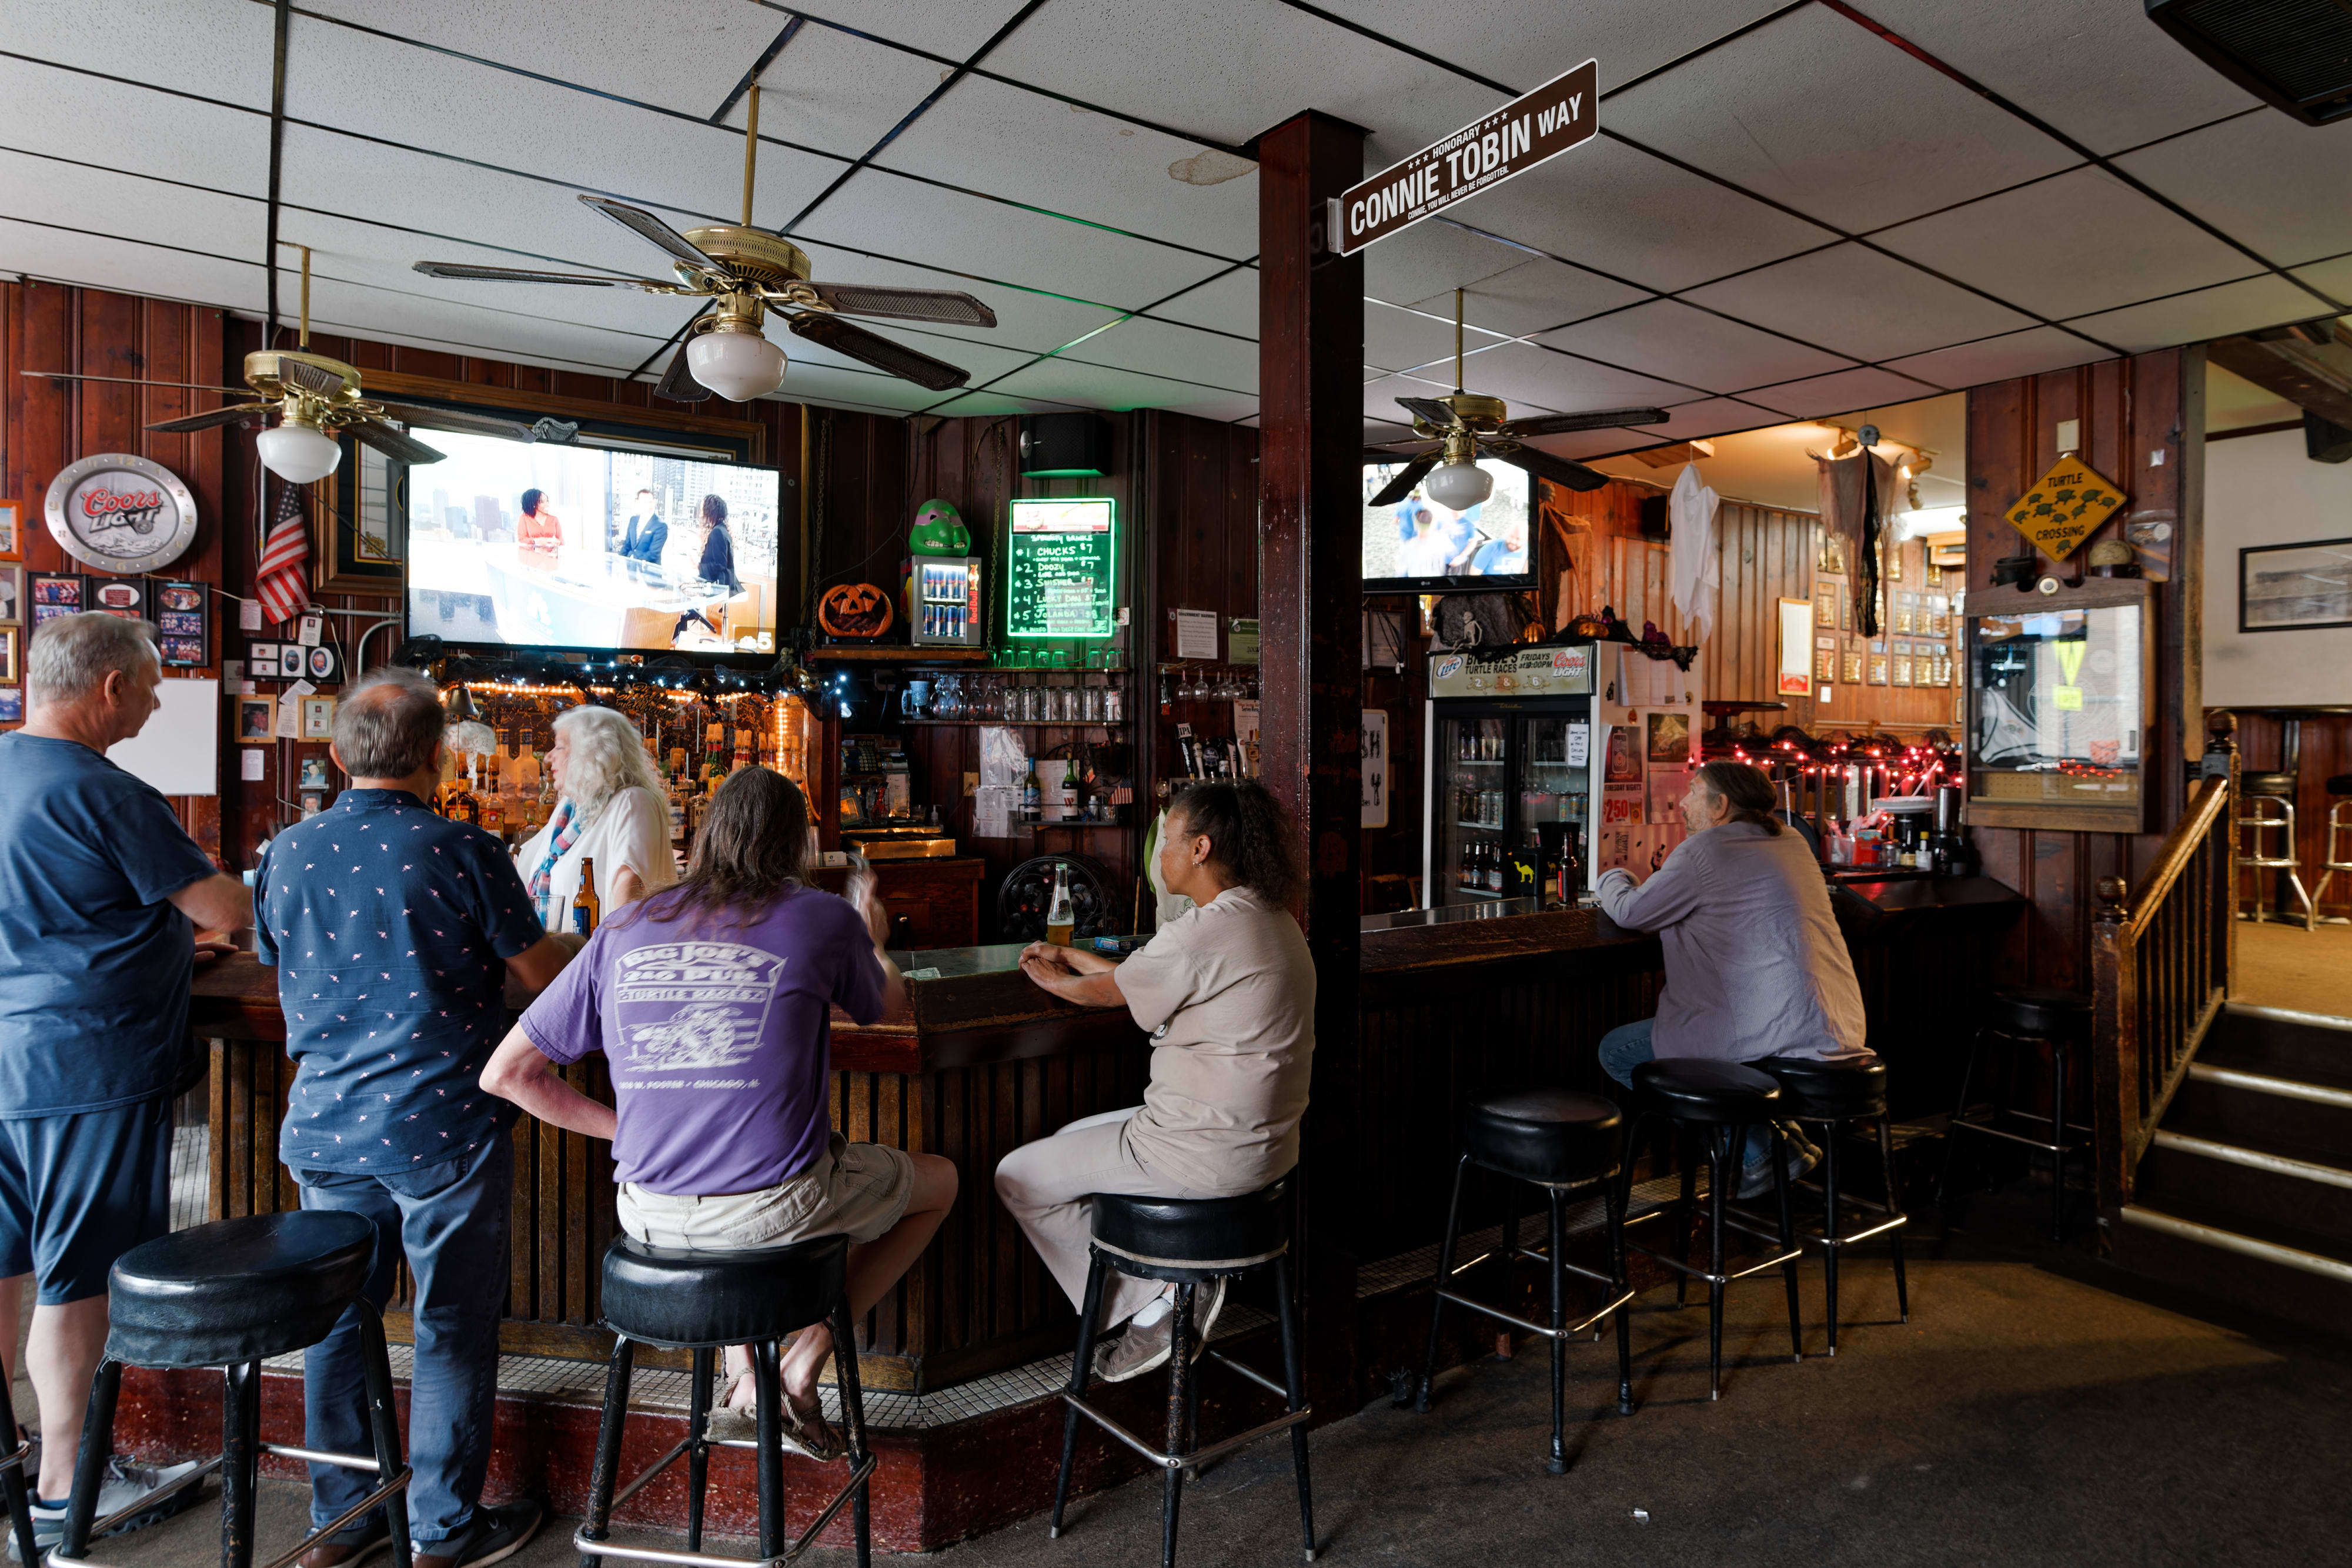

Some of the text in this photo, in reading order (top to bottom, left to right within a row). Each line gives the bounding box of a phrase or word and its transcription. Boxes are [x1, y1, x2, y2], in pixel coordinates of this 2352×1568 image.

[1432, 125, 1481, 158] HONORARY
[1351, 92, 1582, 236] CONNIE TOBIN WAY
[1408, 165, 1509, 220] CONNIE, YOU WILL NEVER BE FORGOTTEN.
[2047, 473, 2084, 487] TURTLE
[81, 489, 162, 516] Coors
[2036, 525, 2085, 540] CROSSING
[1037, 546, 1076, 556] CHUCKS
[1038, 563, 1065, 572] DOOZY
[757, 631, 772, 650] 5
[1521, 653, 1550, 661] FRIDAYS
[1553, 651, 1585, 668] Coors
[1439, 660, 1461, 676] Lite
[1465, 663, 1517, 674] TURTLE RACES
[1552, 666, 1583, 677] LIGHT
[1475, 677, 1539, 687] 2 & 6
[1180, 726, 1191, 735] IPA
[622, 947, 679, 968] BIG
